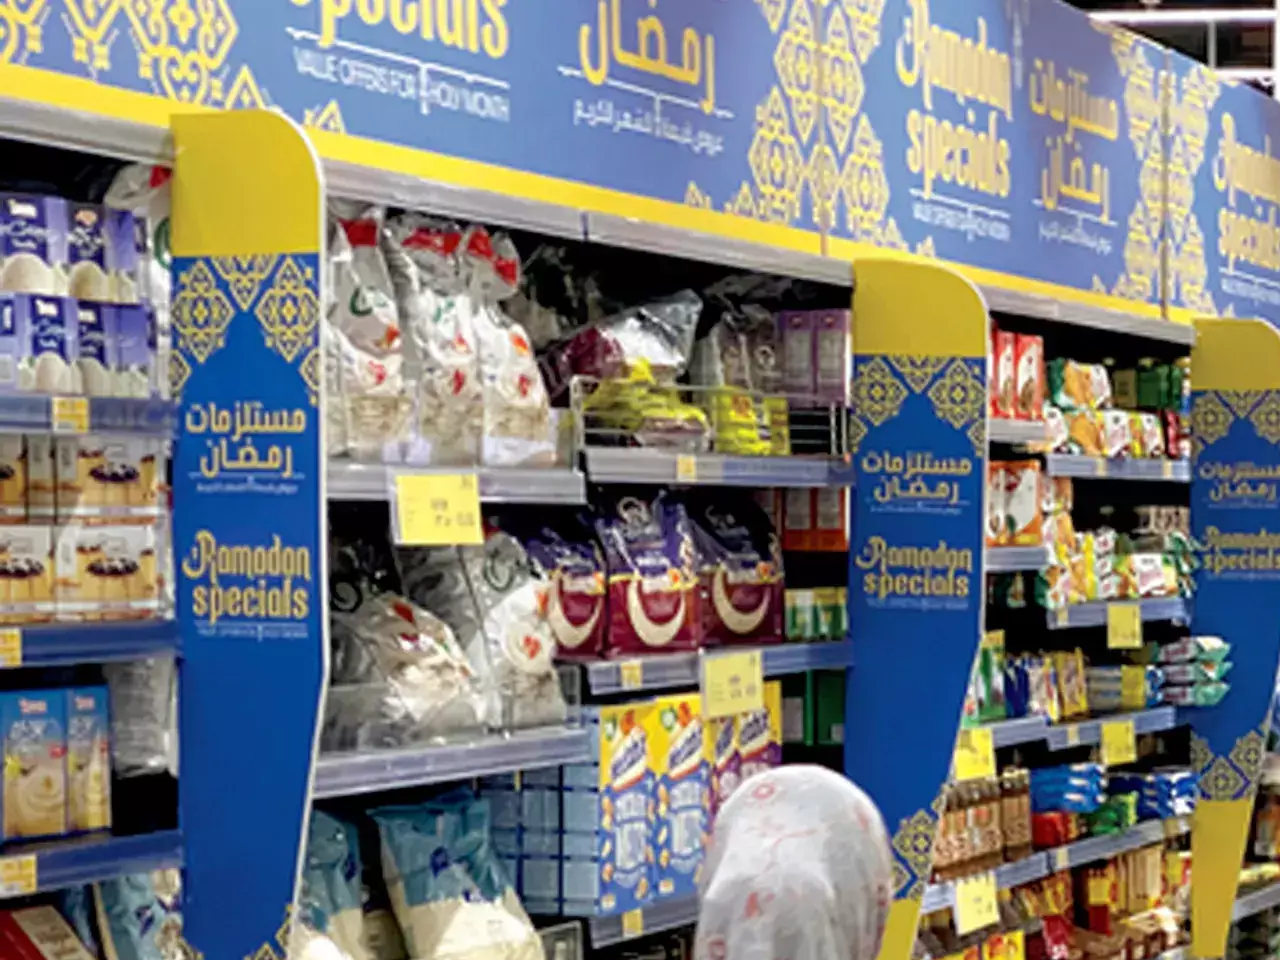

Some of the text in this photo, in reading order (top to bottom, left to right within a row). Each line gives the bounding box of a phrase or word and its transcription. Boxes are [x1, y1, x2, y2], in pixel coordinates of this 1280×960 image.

[291, 0, 508, 59] cials
[907, 108, 1011, 199] specials
[185, 401, 306, 442] مستلزمات
[200, 437, 293, 478] رمضان
[861, 450, 972, 480] مستلزمات
[873, 475, 960, 504] رمضان
[181, 529, 311, 585] Ramadan
[191, 576, 309, 626] specials
[863, 566, 970, 600] specials
